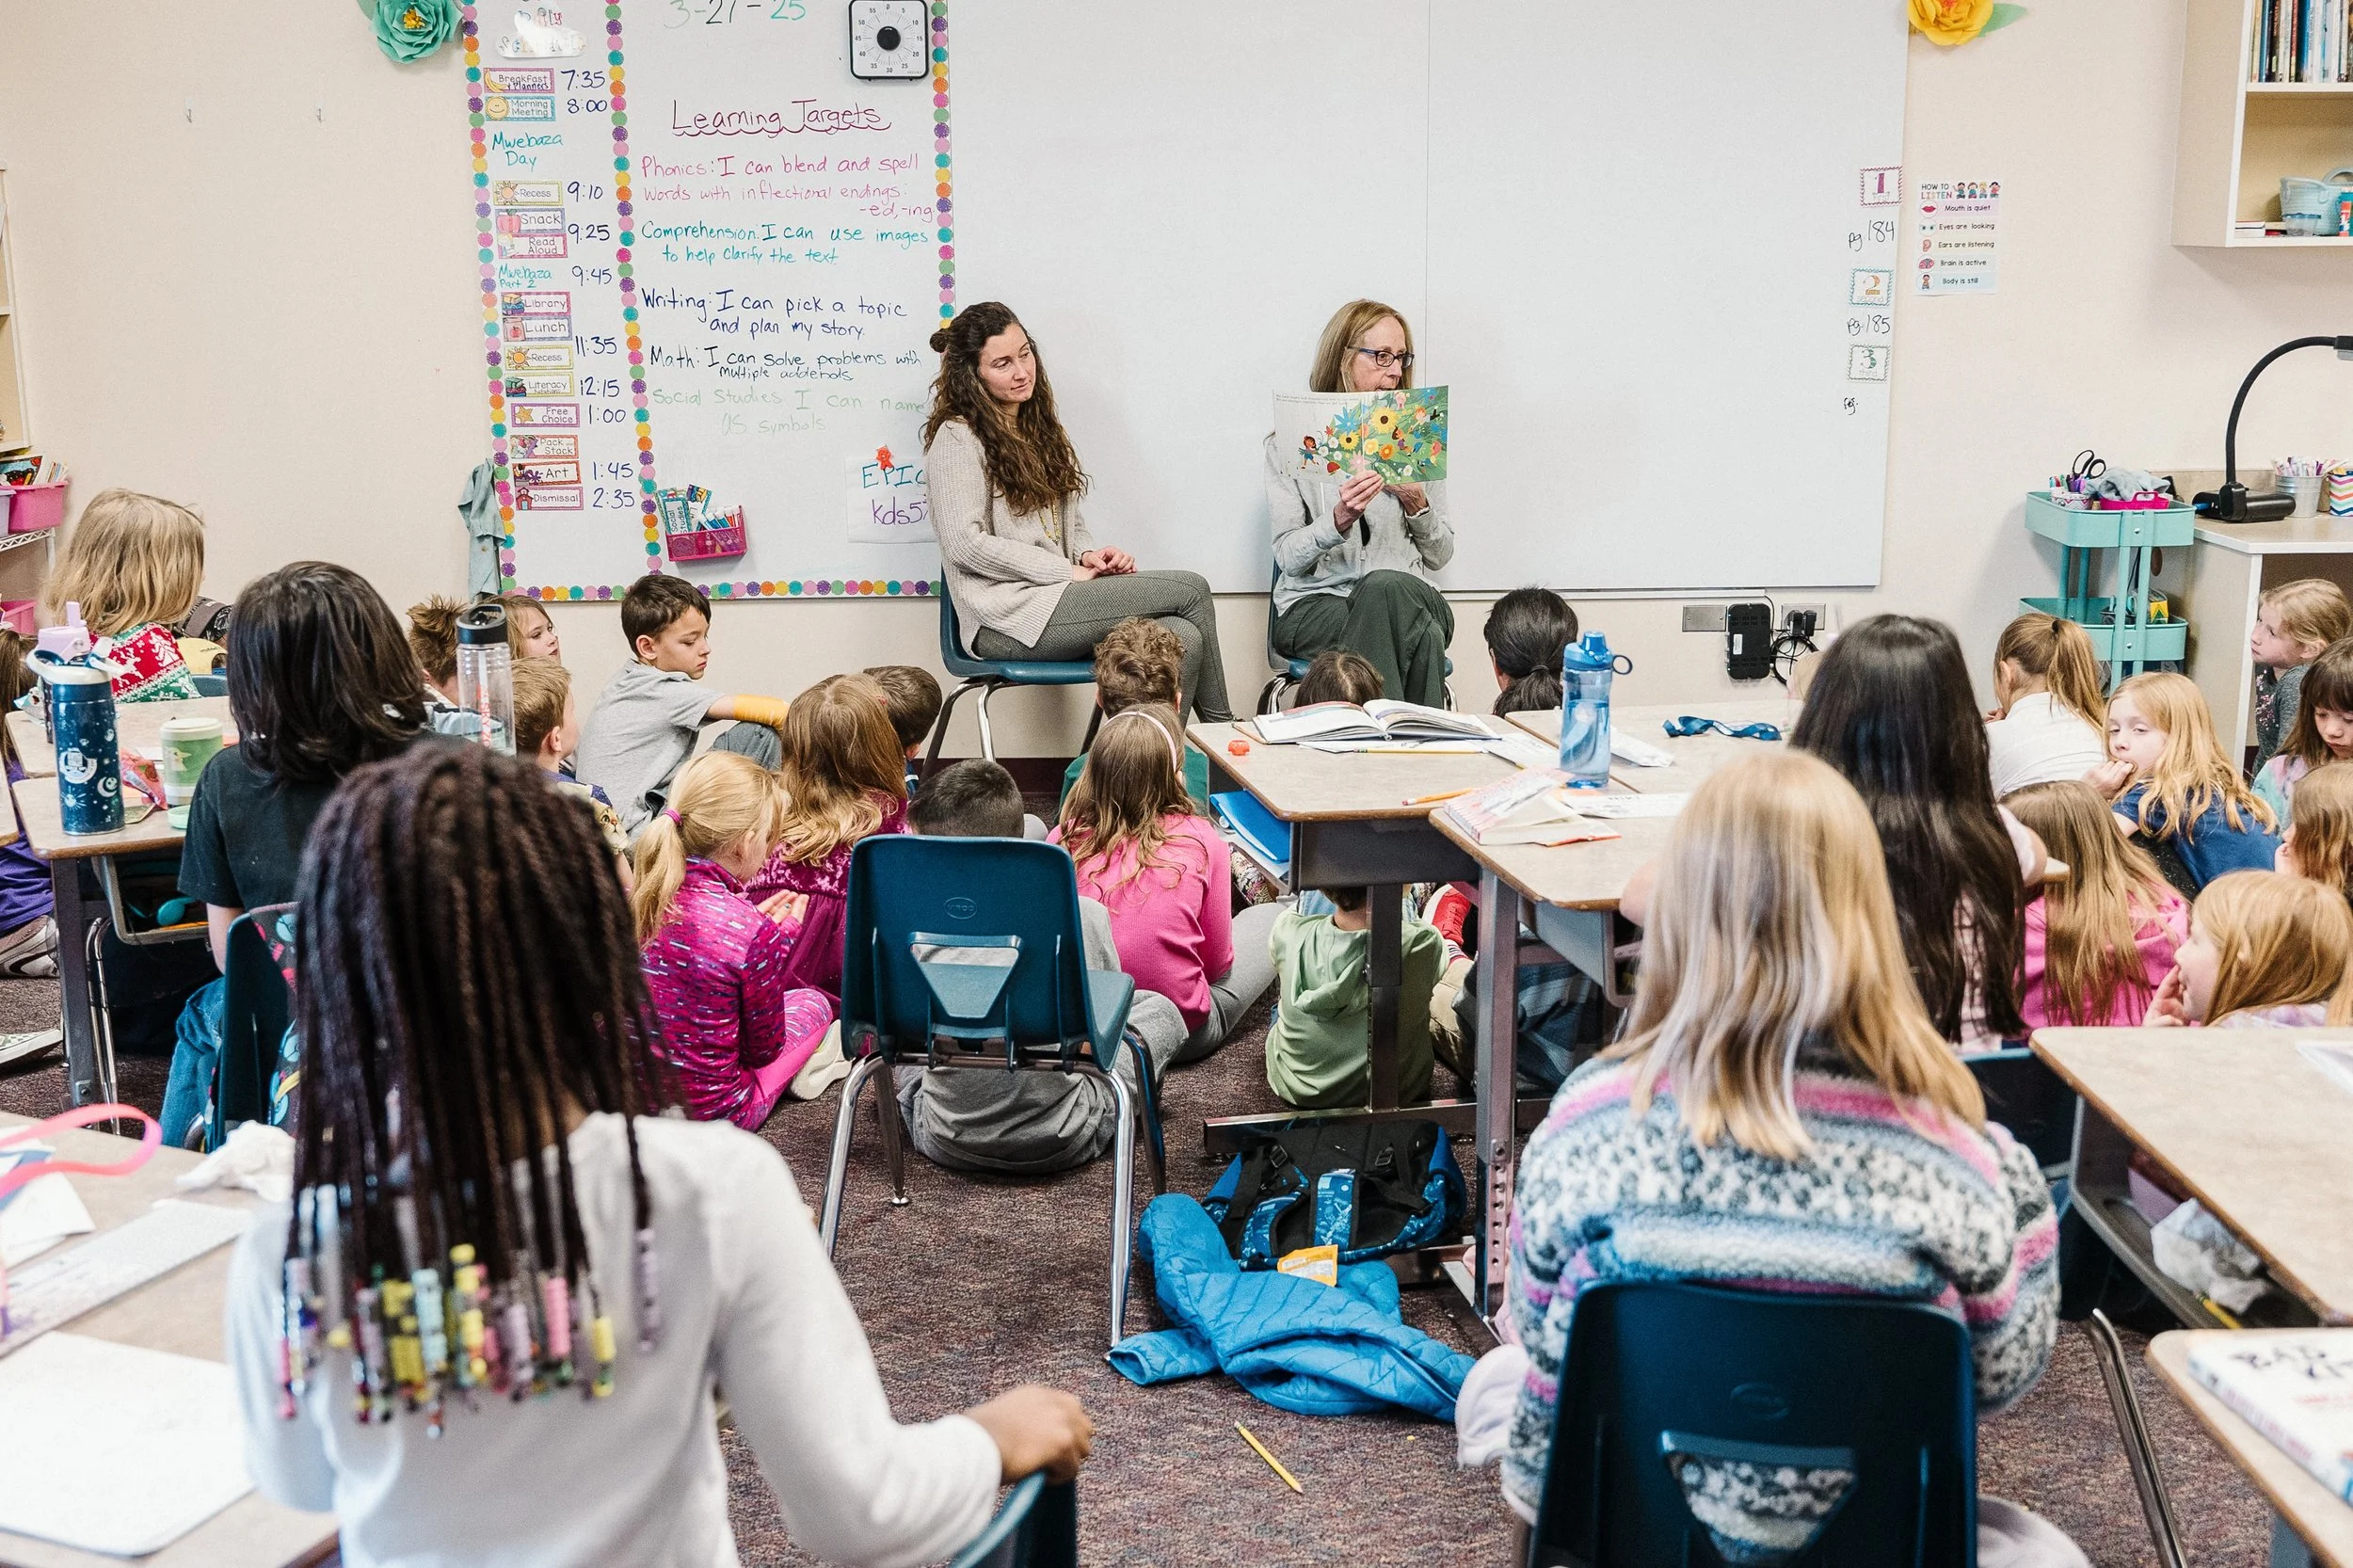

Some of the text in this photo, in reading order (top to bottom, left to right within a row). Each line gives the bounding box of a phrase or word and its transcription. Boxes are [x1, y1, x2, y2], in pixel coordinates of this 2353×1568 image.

[499, 74, 548, 83] Breakfast
[513, 81, 549, 91] Planners
[560, 69, 605, 90] 7:35
[511, 100, 549, 109] Morning
[511, 108, 549, 118] Meeting
[567, 98, 608, 114] 8:00
[672, 98, 882, 139] Learning Targets
[505, 151, 536, 172] Day
[642, 152, 919, 178] Phonics: I can blend and spell
[520, 188, 552, 198] Recess
[568, 181, 603, 202] 9:10
[700, 185, 731, 201] with
[742, 180, 832, 200] inflectional
[1873, 172, 1890, 195] 1
[1921, 191, 1953, 200] LISTEN
[520, 212, 561, 225] Snack
[568, 223, 611, 244] 9:25
[761, 223, 777, 241] I
[783, 226, 814, 240] can
[830, 227, 865, 241] use
[875, 228, 929, 249] images
[1867, 219, 1895, 243] 184
[528, 237, 555, 247] Read
[528, 246, 558, 255] Aloud
[663, 244, 679, 263] to
[686, 246, 716, 266] help
[770, 247, 797, 264] the
[527, 279, 536, 288] 2
[571, 265, 613, 286] 9:45
[1863, 275, 1881, 295] 2
[524, 298, 566, 311] Library
[642, 287, 907, 323] Writing: I can pick a topic
[525, 322, 567, 333] Lunch
[710, 316, 740, 334] and
[749, 317, 779, 341] plan
[792, 321, 813, 342] my
[1865, 314, 1891, 334] 185
[575, 335, 617, 357] 11:35
[531, 352, 563, 361] Recess
[650, 344, 700, 369] Math:
[704, 345, 720, 367] I
[727, 352, 756, 365] can
[817, 350, 887, 370] problems
[896, 350, 922, 367] with
[1861, 349, 1877, 369] 3
[528, 380, 568, 391] Literacy
[580, 376, 620, 398] 12:15
[652, 388, 701, 406] Social
[795, 390, 812, 410] I
[541, 415, 574, 424] Choice
[588, 404, 627, 424] 1:00
[721, 412, 827, 437] US symbols
[539, 438, 565, 446] Pack
[544, 446, 574, 455] Stack
[546, 468, 569, 478] Art
[593, 461, 633, 481] 1:45
[534, 492, 579, 503] Dismissal
[592, 487, 635, 509] 2:35
[667, 509, 678, 533] Social
